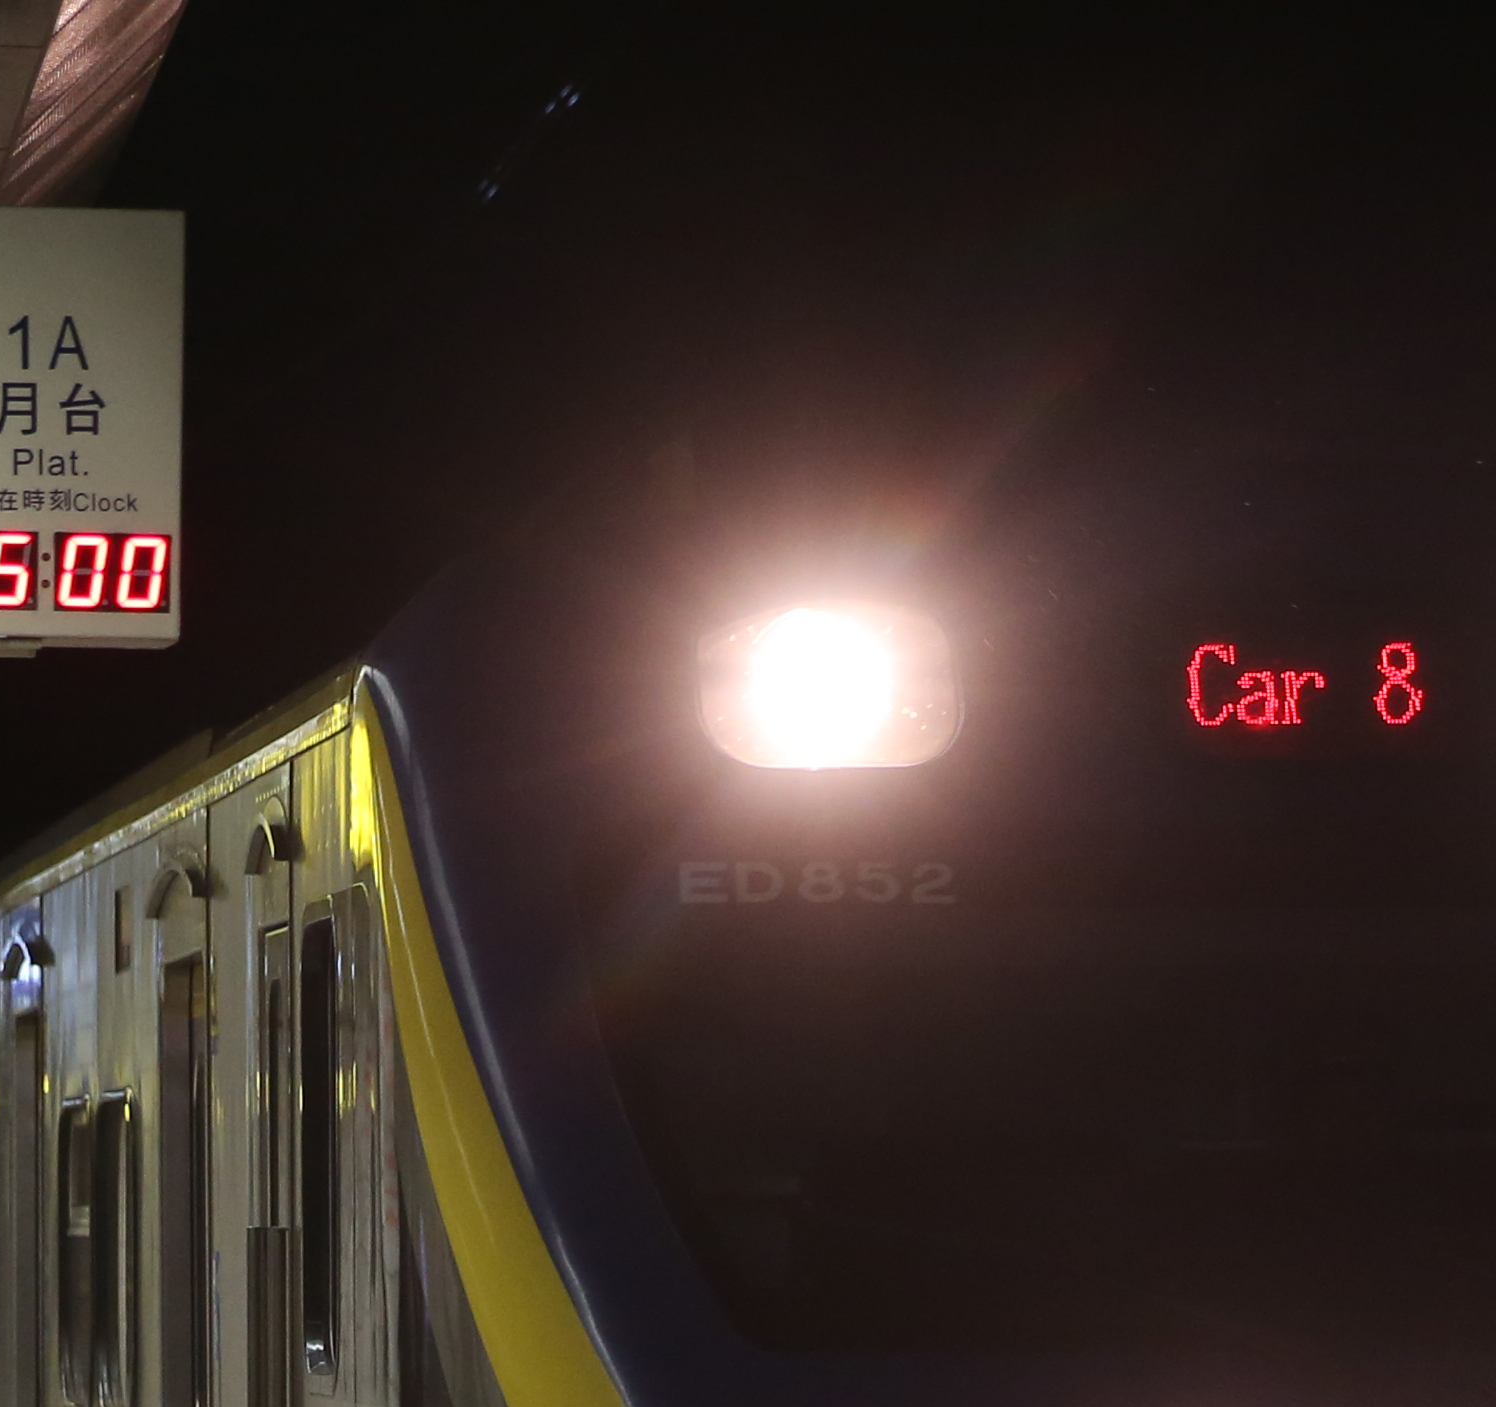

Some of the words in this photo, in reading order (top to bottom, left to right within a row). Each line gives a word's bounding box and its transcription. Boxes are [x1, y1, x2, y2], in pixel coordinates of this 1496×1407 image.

[8, 314, 89, 371] 1A
[13, 448, 89, 477] Plat.
[1186, 643, 1326, 727] Car
[1373, 641, 1424, 726] 8
[678, 861, 959, 904] ED852
